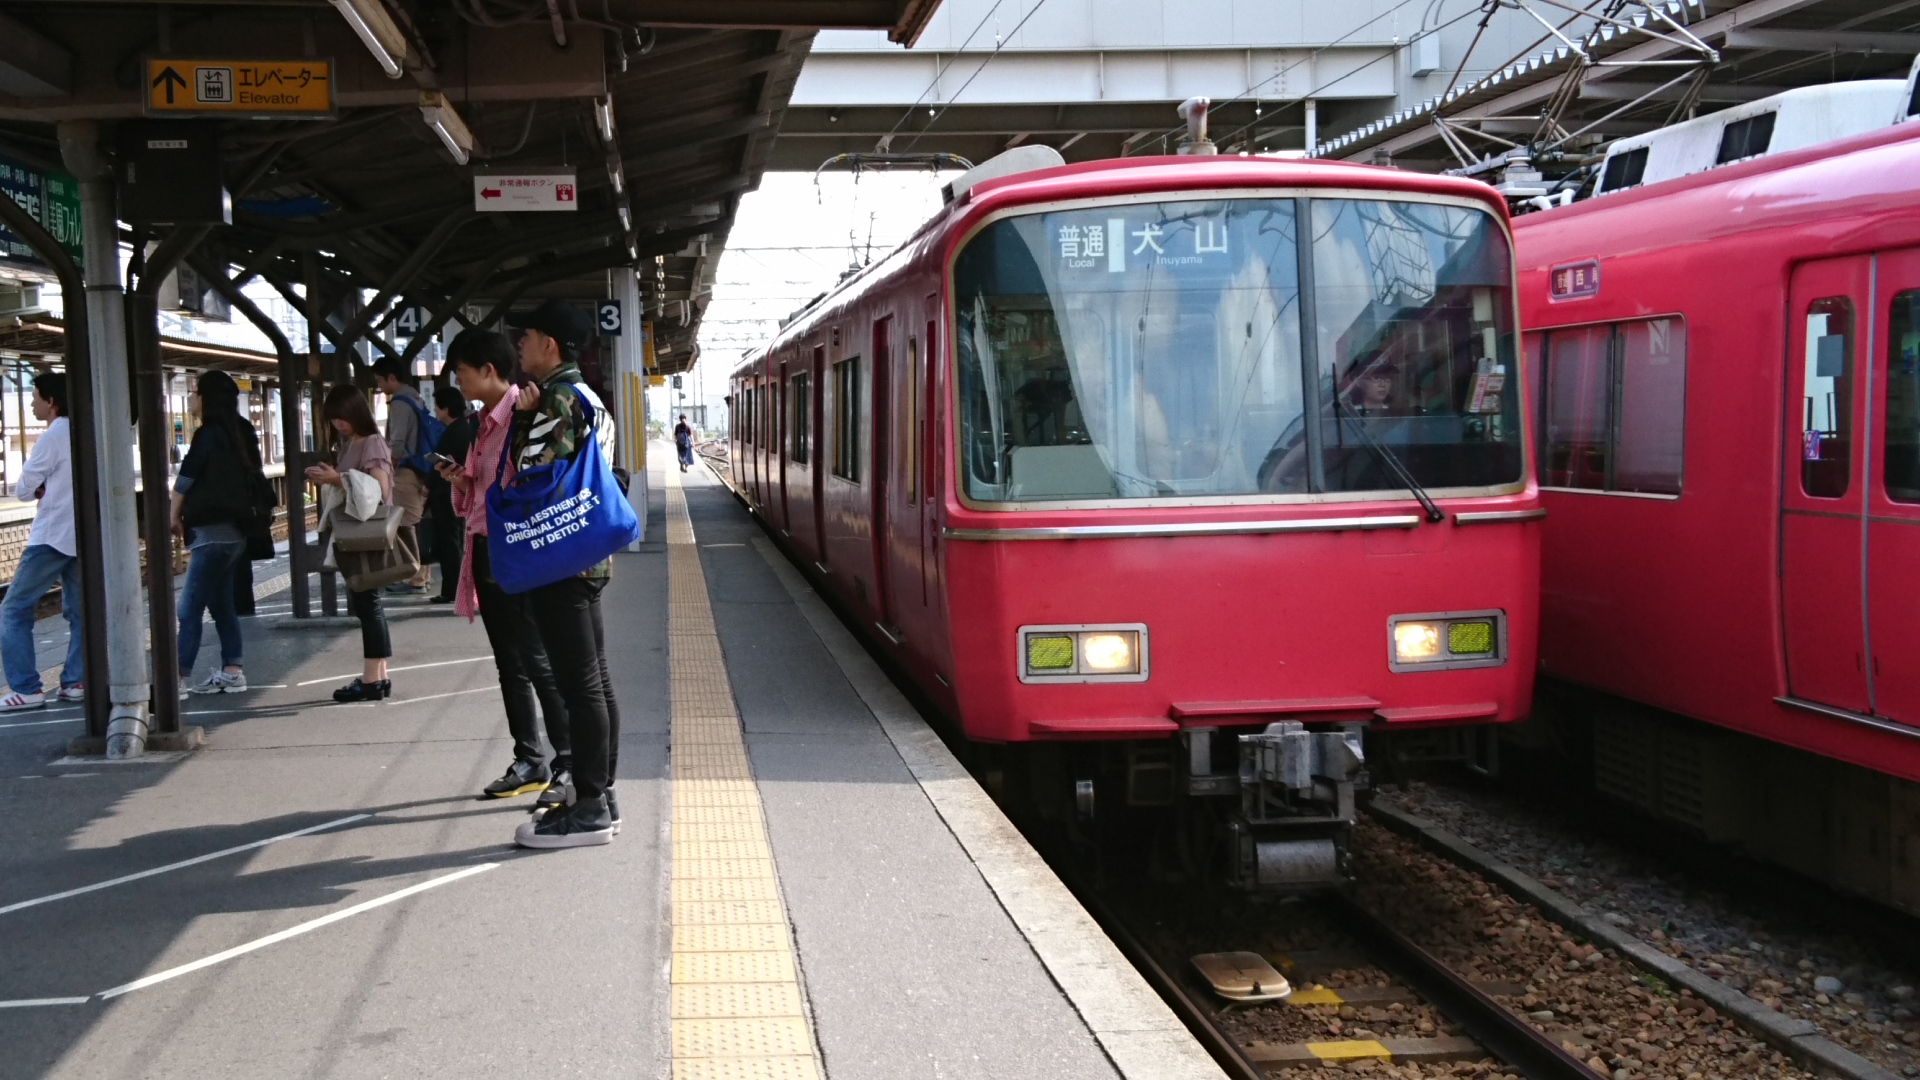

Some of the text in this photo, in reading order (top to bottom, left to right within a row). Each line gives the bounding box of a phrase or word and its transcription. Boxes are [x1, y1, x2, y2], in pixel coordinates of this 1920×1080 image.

[239, 67, 327, 88] エレベーター
[239, 92, 300, 104] Elevator
[500, 179, 554, 187] 非常通報ボタン
[49, 201, 83, 246] 美園フォレ
[1058, 225, 1104, 258] 普通
[1069, 258, 1095, 268] Local
[1156, 255, 1203, 266] Inuyama
[398, 307, 419, 332] 4
[600, 305, 621, 331] 3
[675, 378, 681, 387] 3
[530, 487, 592, 526] AESTHENTICS
[505, 495, 600, 544] ORIGINAL DOUBLE T
[530, 516, 589, 550] BY DETTO K
